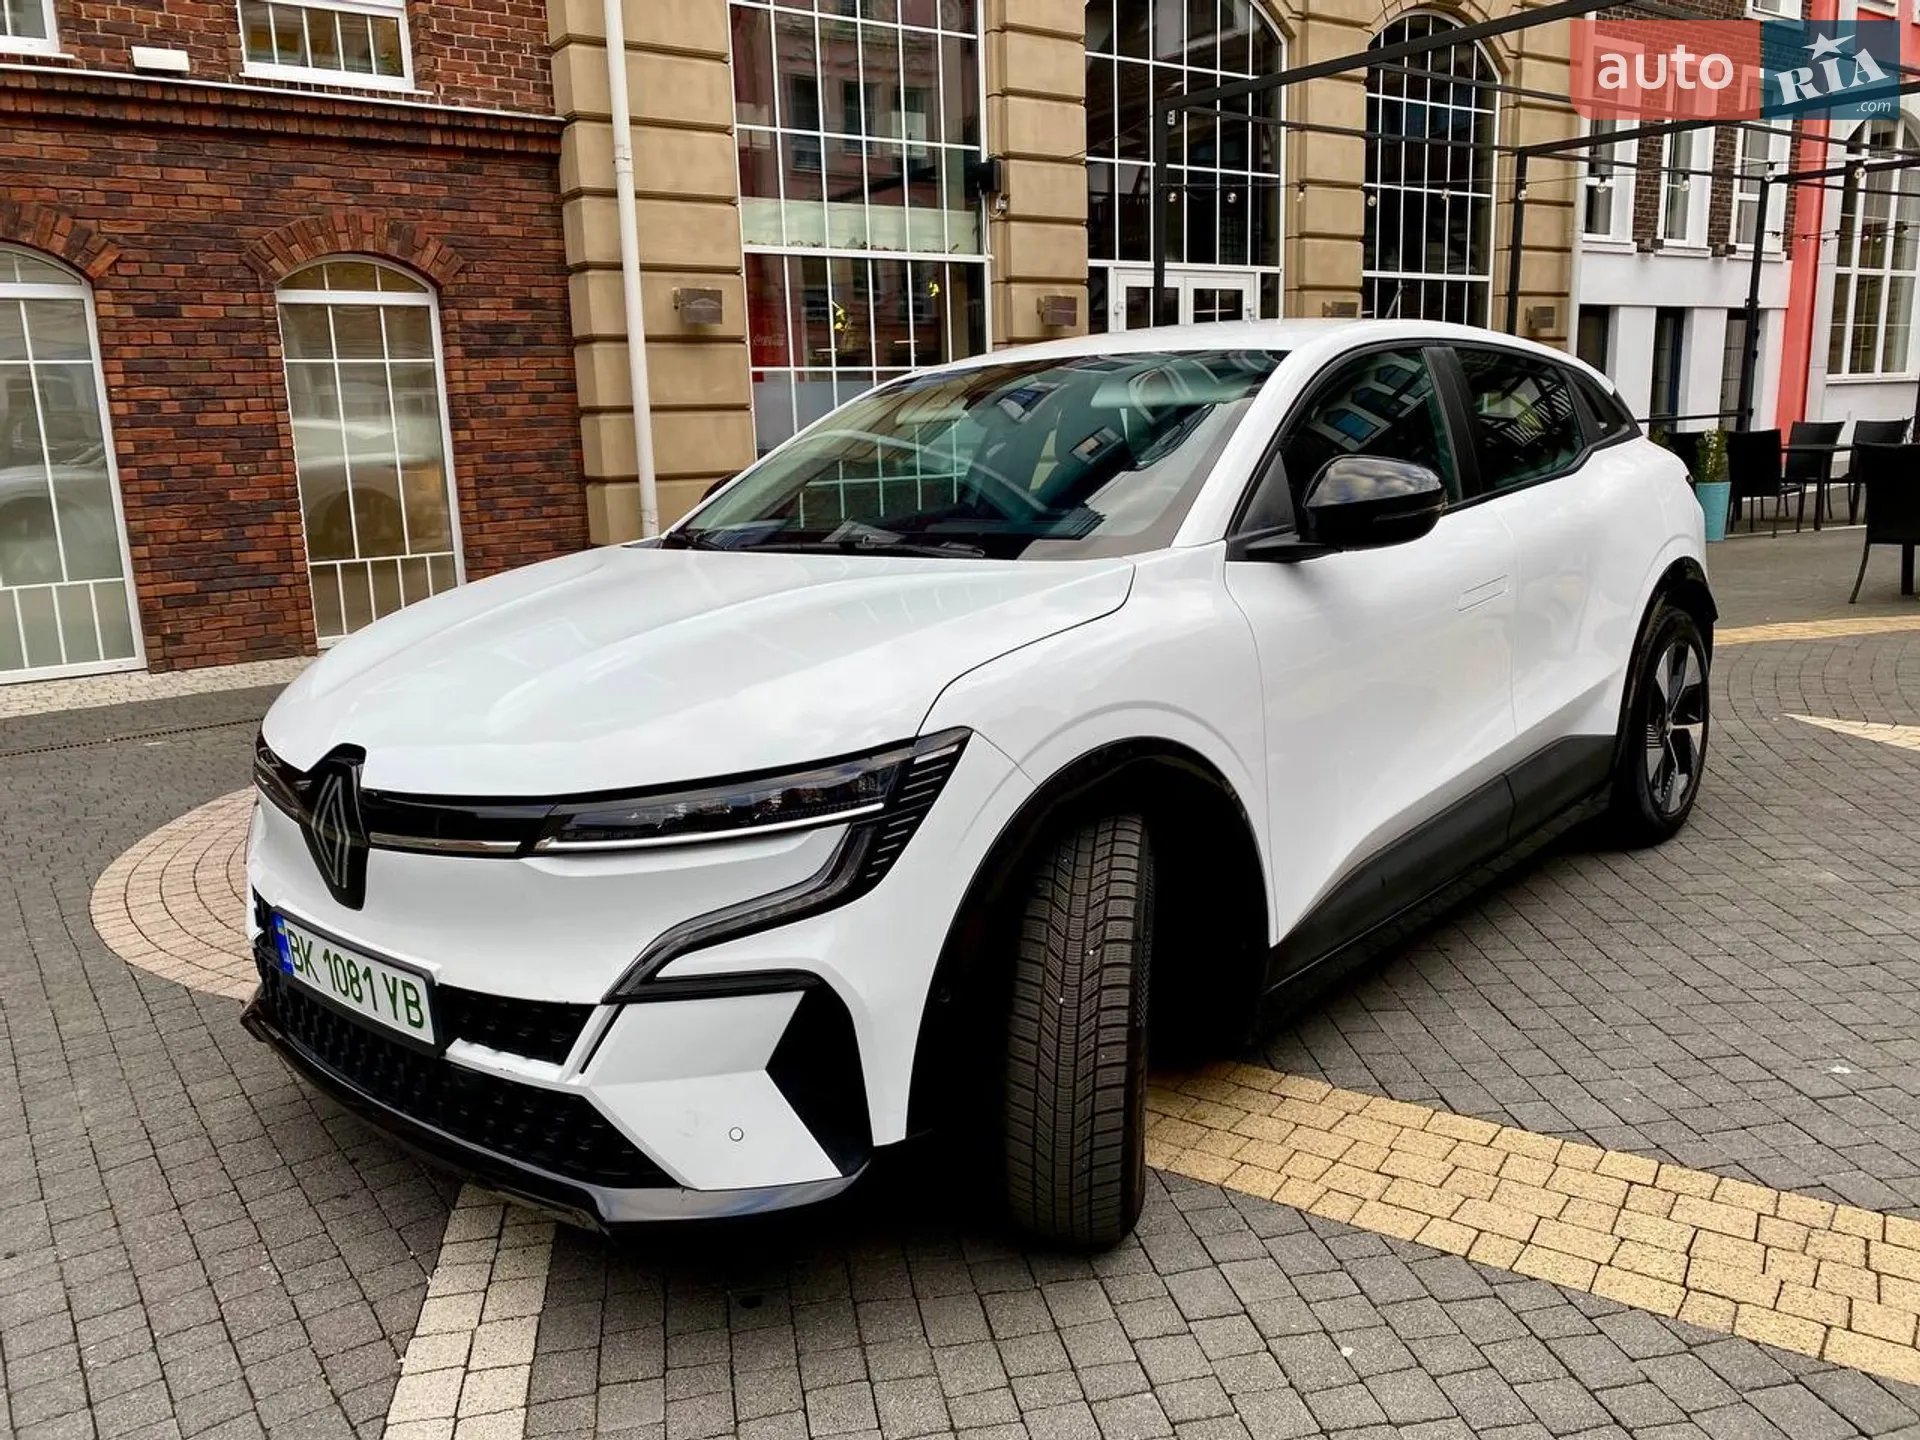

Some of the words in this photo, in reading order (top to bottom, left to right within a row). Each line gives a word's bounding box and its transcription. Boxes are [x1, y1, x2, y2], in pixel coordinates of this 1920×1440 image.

[287, 928, 320, 984] BK
[322, 948, 379, 1012] 1081
[382, 971, 425, 1029] YB
